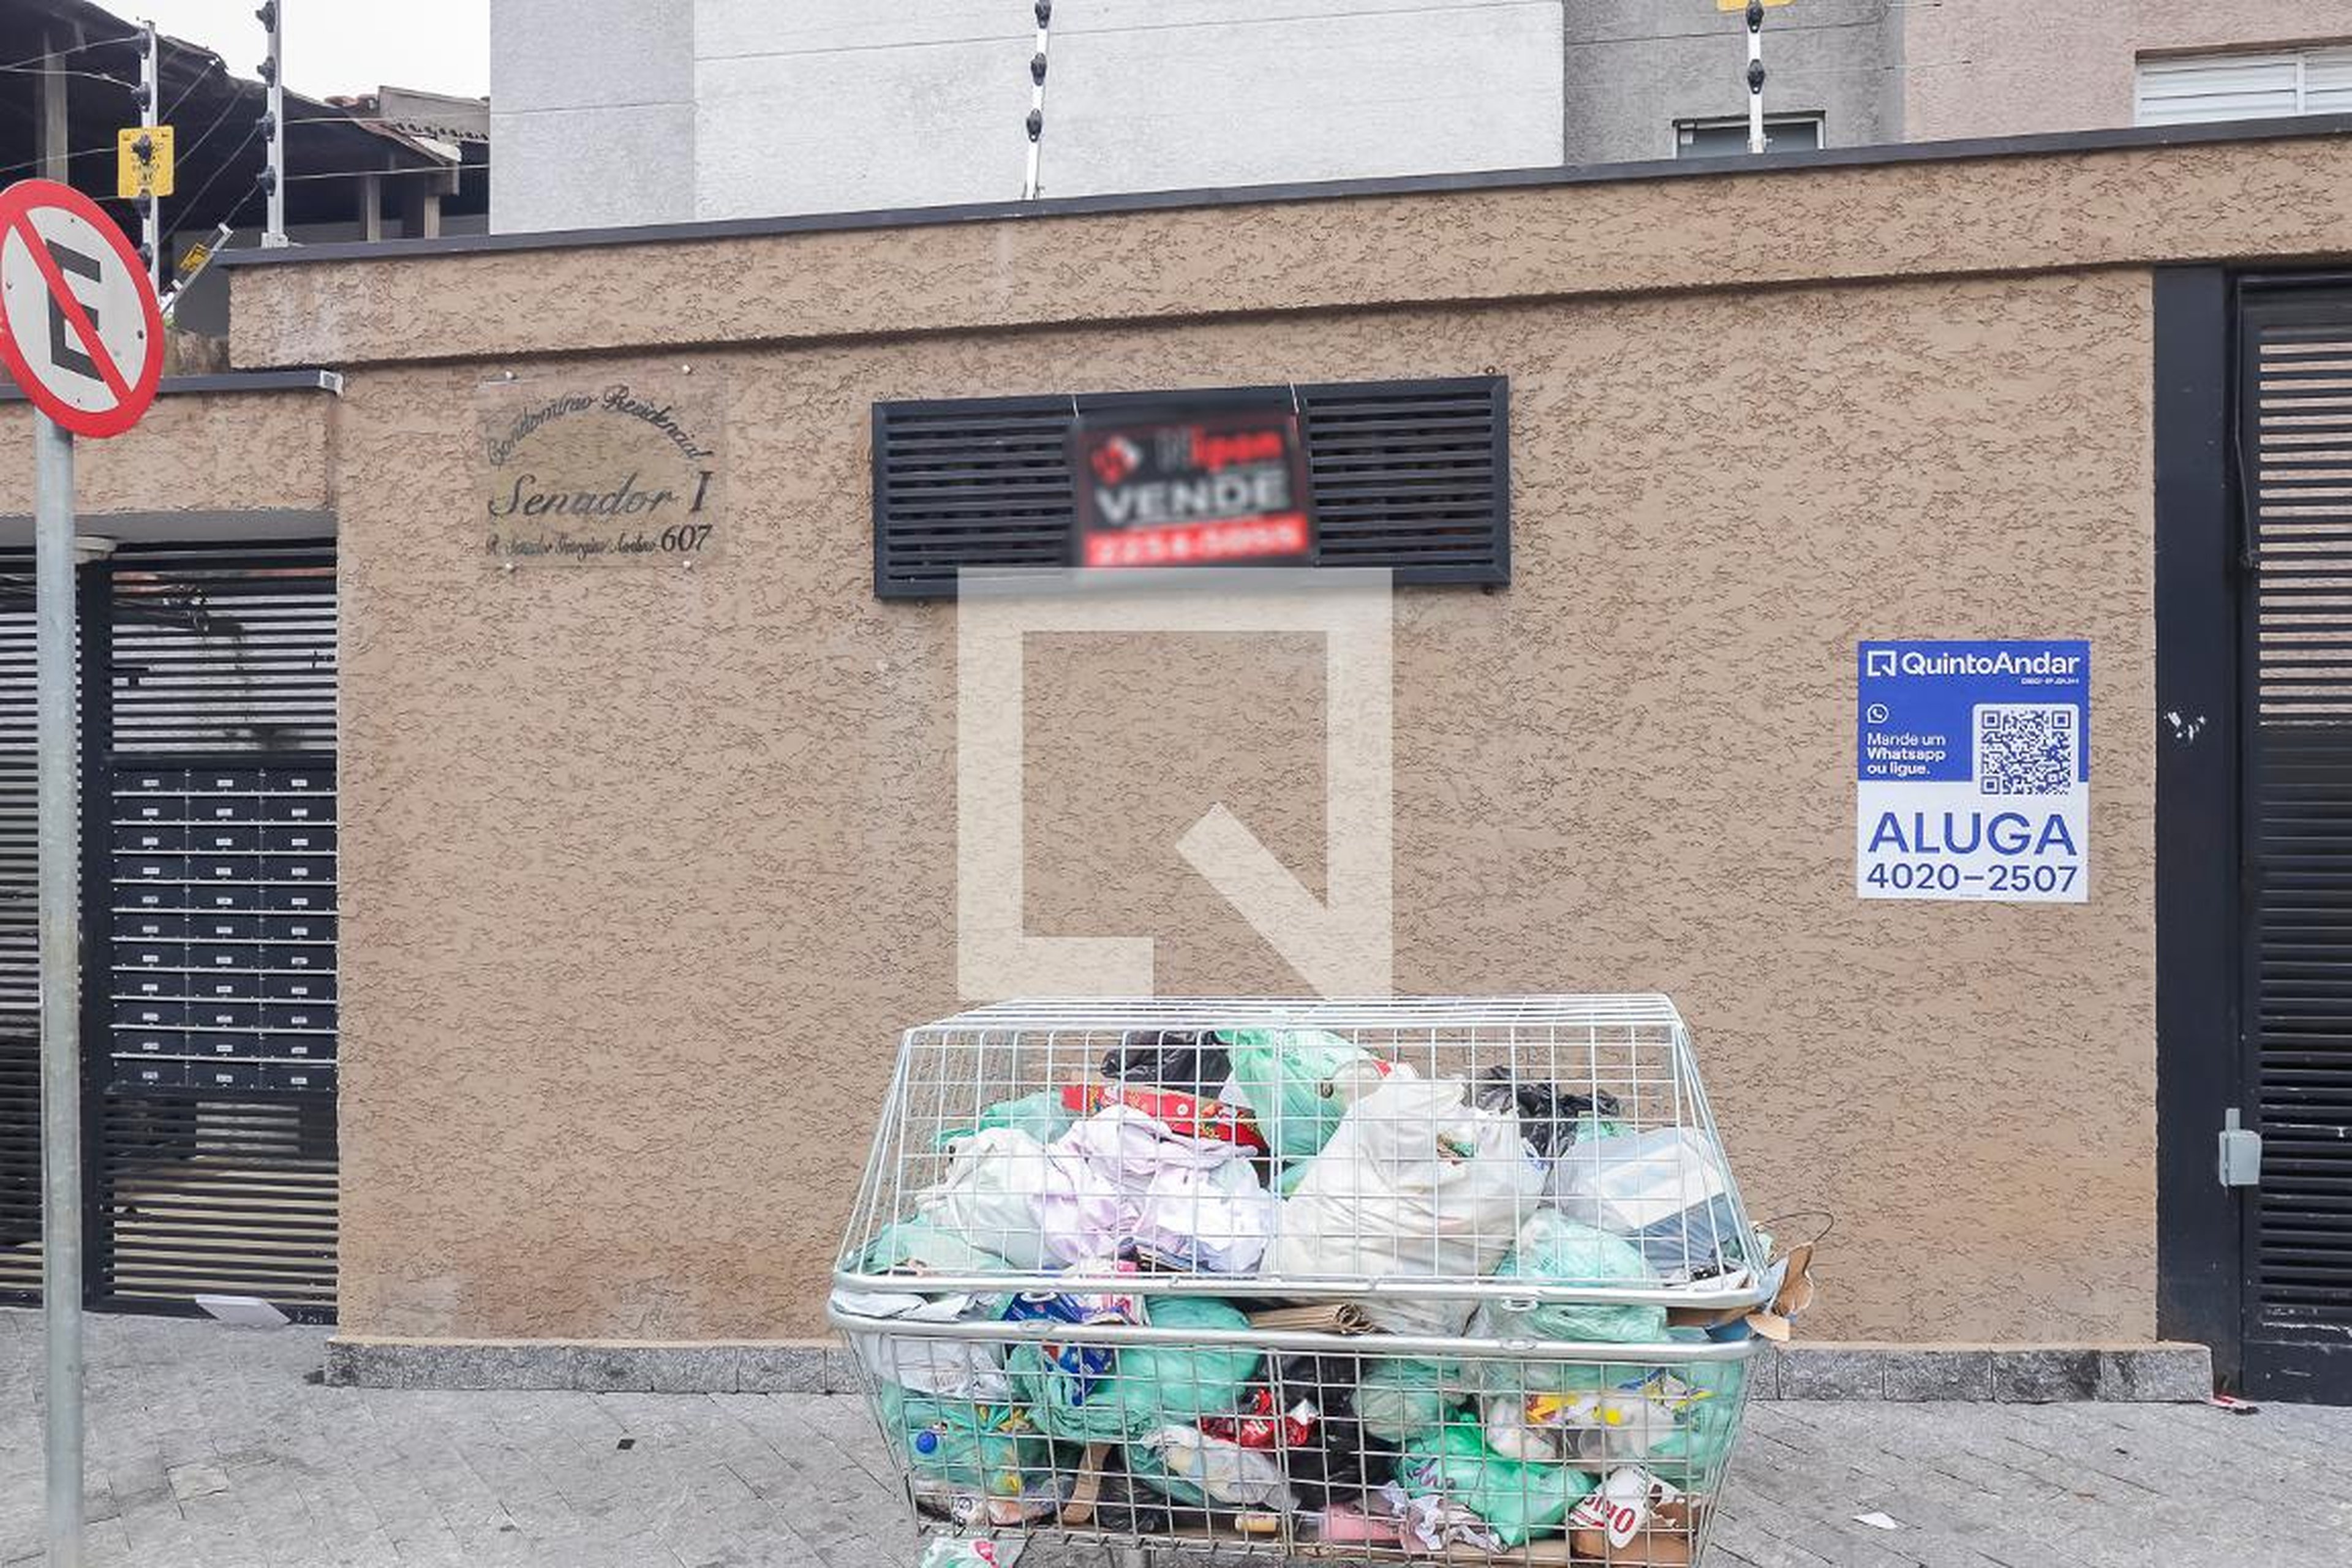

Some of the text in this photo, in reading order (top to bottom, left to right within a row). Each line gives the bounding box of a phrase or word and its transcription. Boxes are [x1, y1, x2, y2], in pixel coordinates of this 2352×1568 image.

[489, 471, 715, 518] Senador I
[1095, 469, 1290, 524] VENDE
[661, 524, 713, 552] 607
[1901, 652, 2080, 676] QuintoAndar
[1867, 733, 1946, 746] Mande um
[1867, 748, 1947, 762] Whatsapp
[1867, 762, 1931, 777] ou ligue.
[1868, 812, 2078, 856] ALUGA
[1867, 863, 2078, 892] 4020-2507
